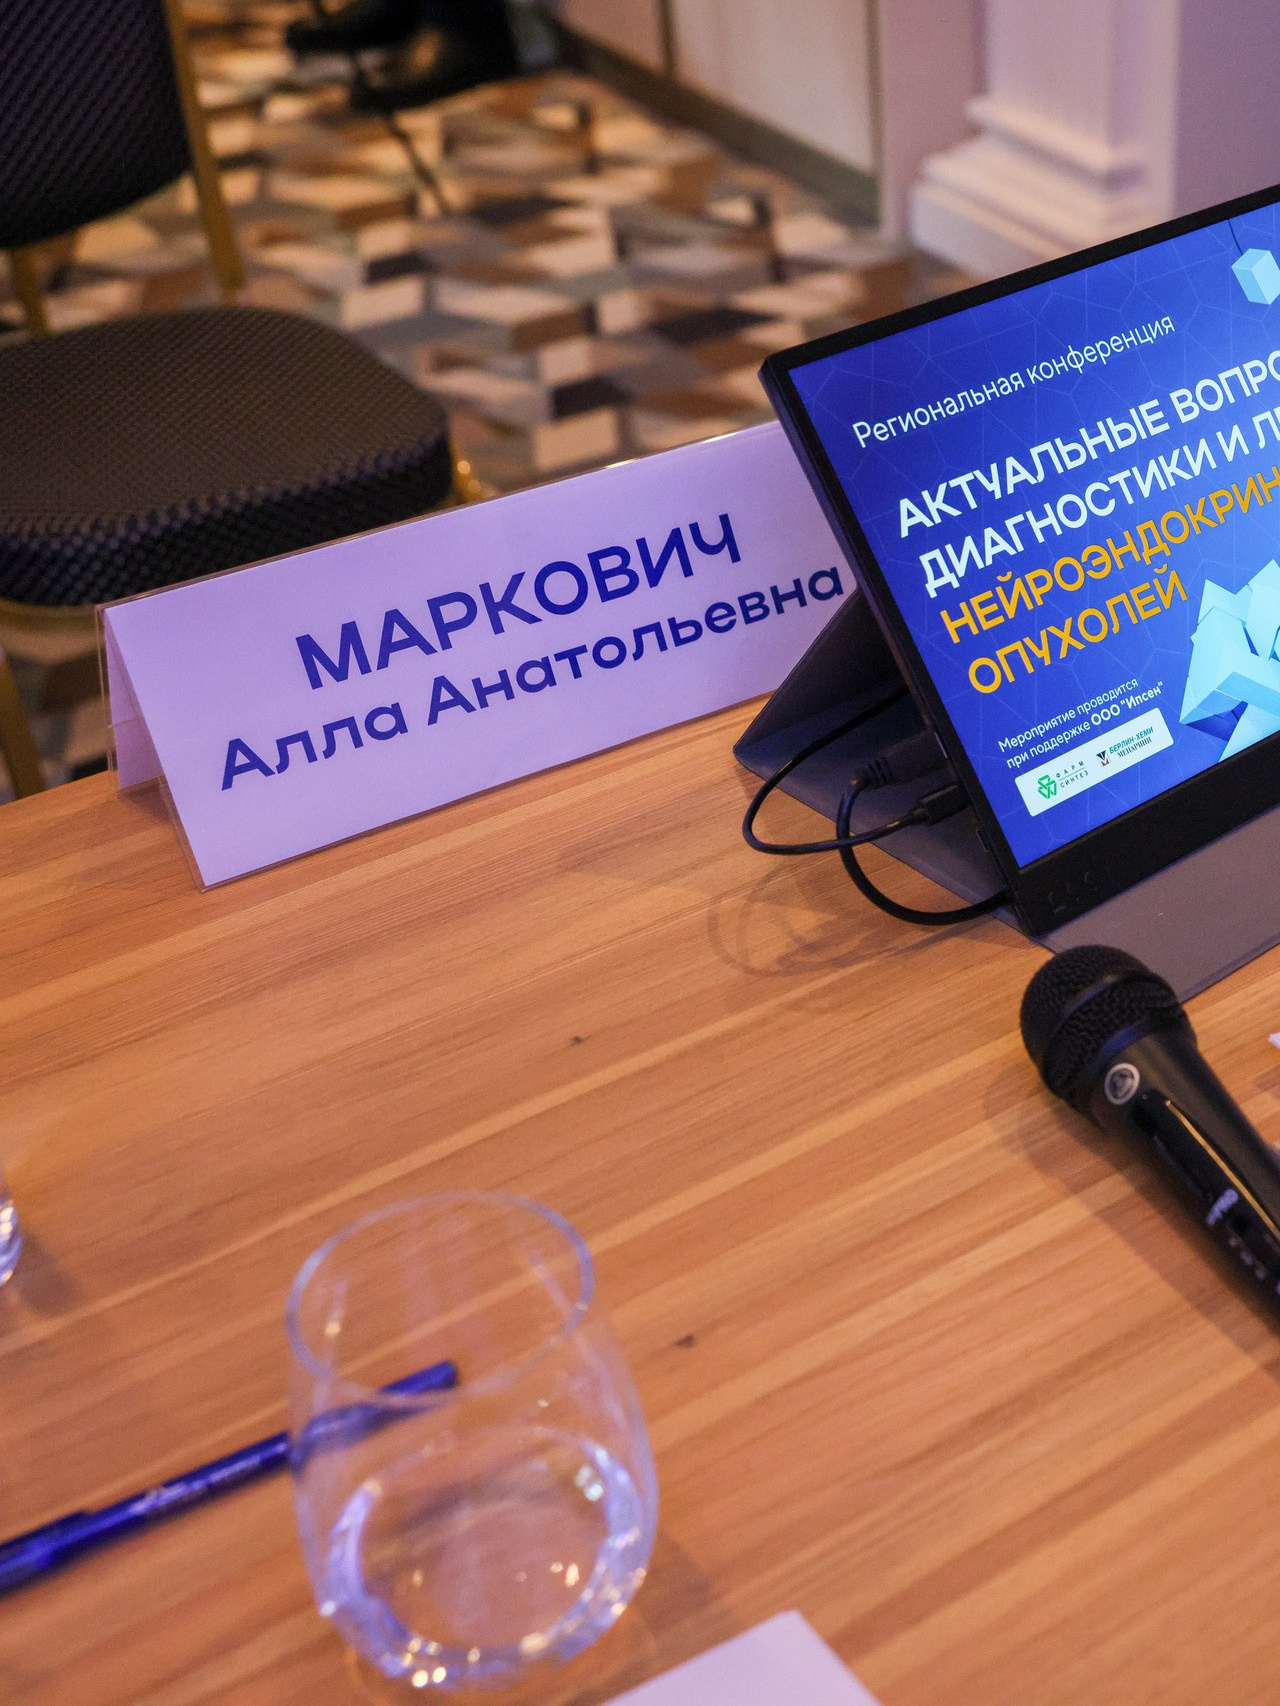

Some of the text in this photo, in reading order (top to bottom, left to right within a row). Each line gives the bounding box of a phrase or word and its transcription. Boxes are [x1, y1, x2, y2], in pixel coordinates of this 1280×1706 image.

[852, 316, 1176, 448] Региональная конференция
[899, 399, 1170, 538] АКТУАЛЬНЫЕ
[919, 437, 1216, 597] ДИАГНОСТИКИ
[1216, 424, 1250, 462] И
[295, 512, 742, 690] МАРКОВИЧ
[968, 562, 1188, 694] ОПУХОЛЕЙ
[220, 565, 844, 791] Алла Анатольевна
[998, 678, 1139, 753] Мероприятие проводится
[1006, 751, 1030, 770] при
[1029, 721, 1091, 759] поддержке
[1090, 704, 1121, 727] ООО
[1109, 726, 1154, 754] БЕРЛИН-ХЕМИ
